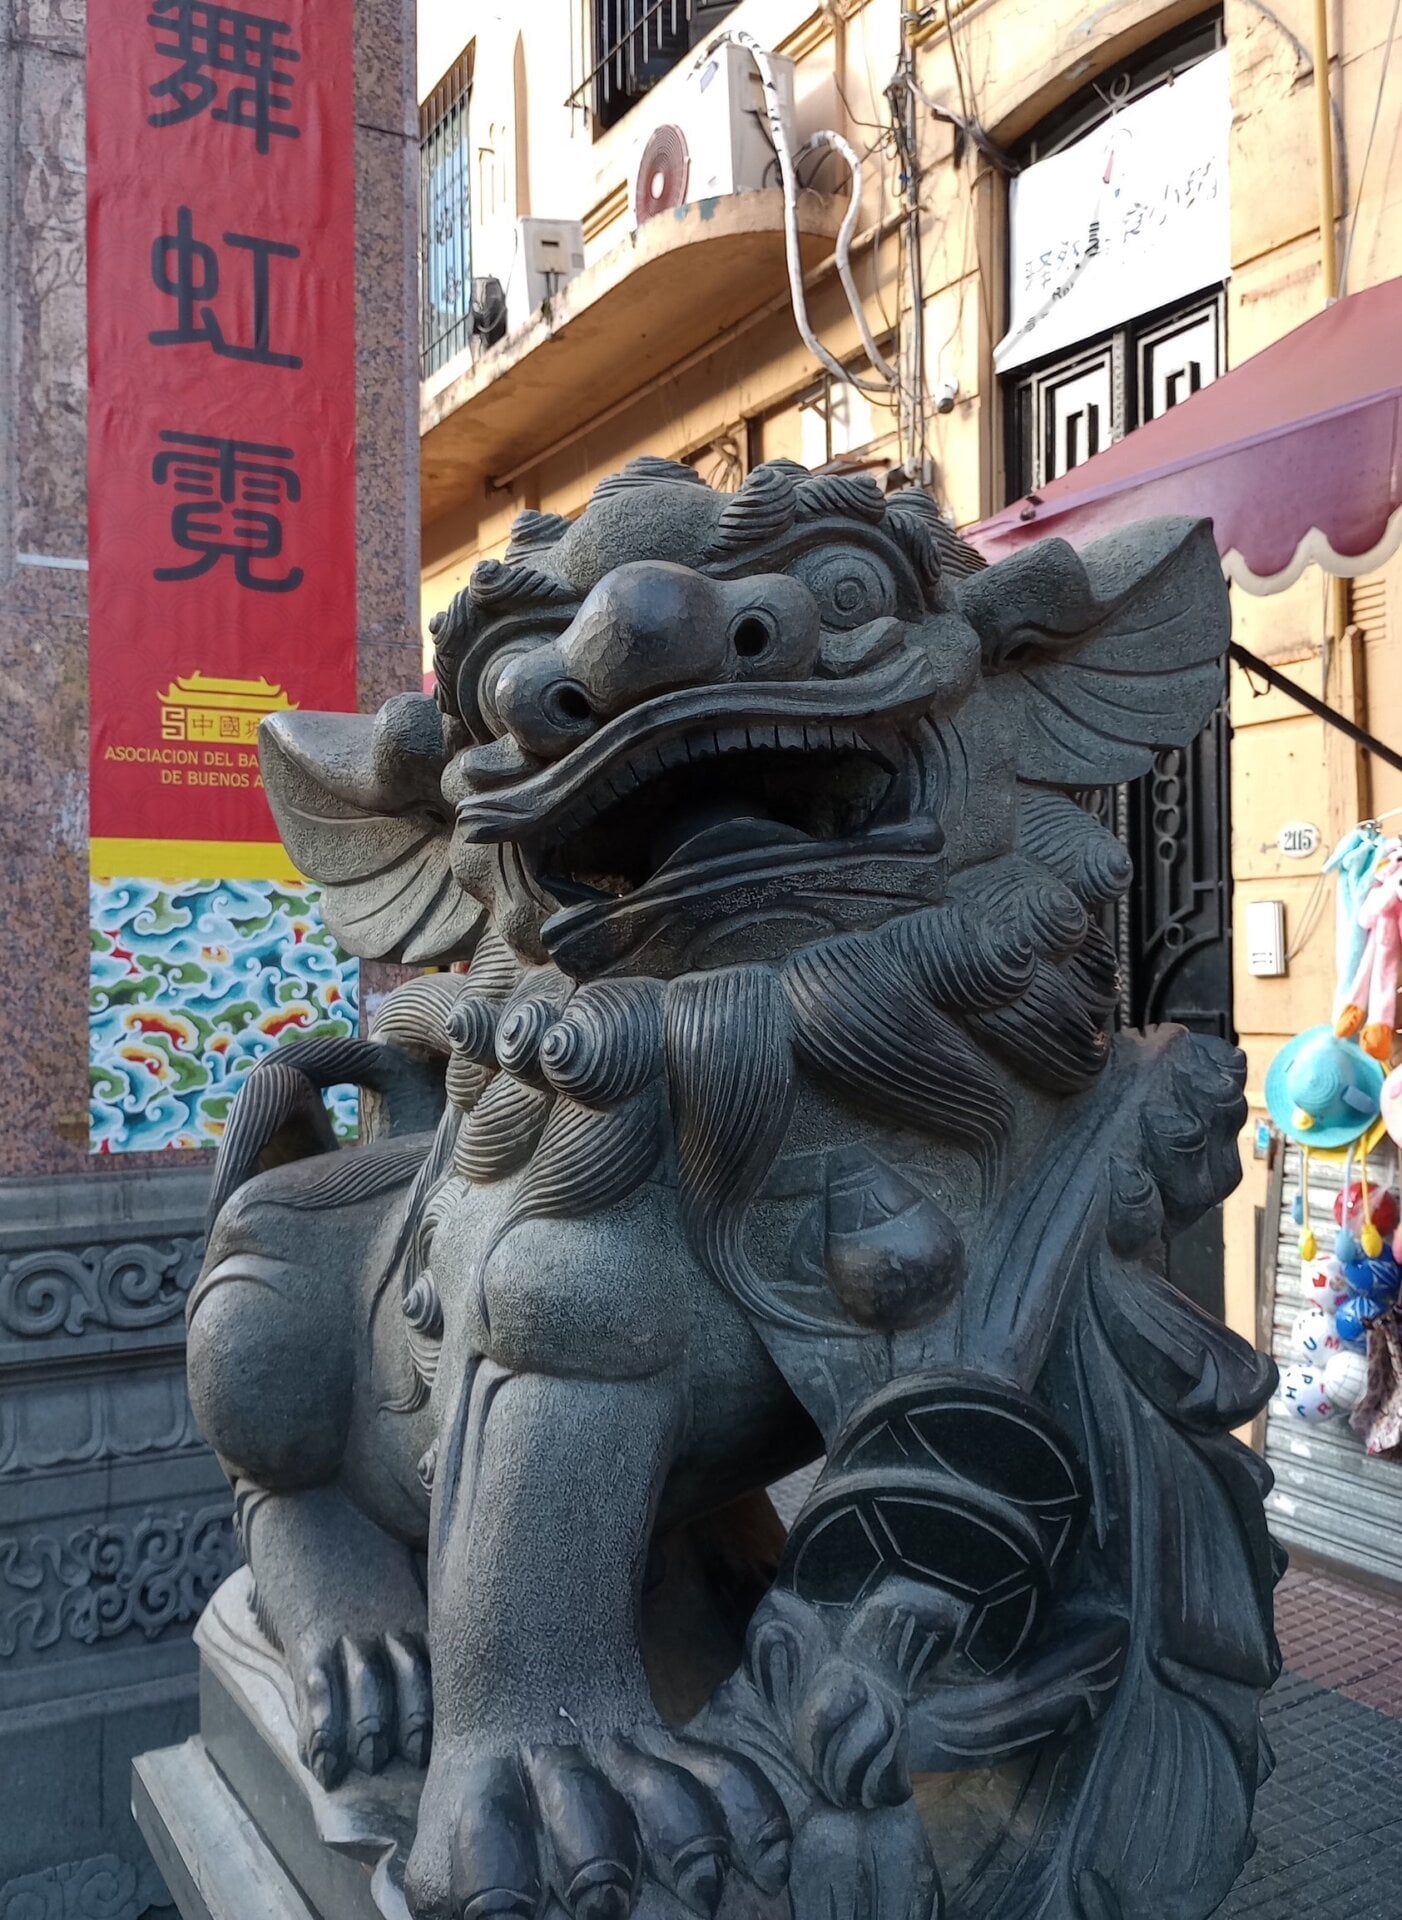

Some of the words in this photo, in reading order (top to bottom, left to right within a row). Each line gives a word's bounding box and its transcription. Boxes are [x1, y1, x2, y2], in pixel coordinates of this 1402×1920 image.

[105, 746, 198, 765] ASOCIACION
[204, 751, 234, 767] DEL
[161, 769, 183, 785] DE
[187, 771, 250, 788] BUENOS
